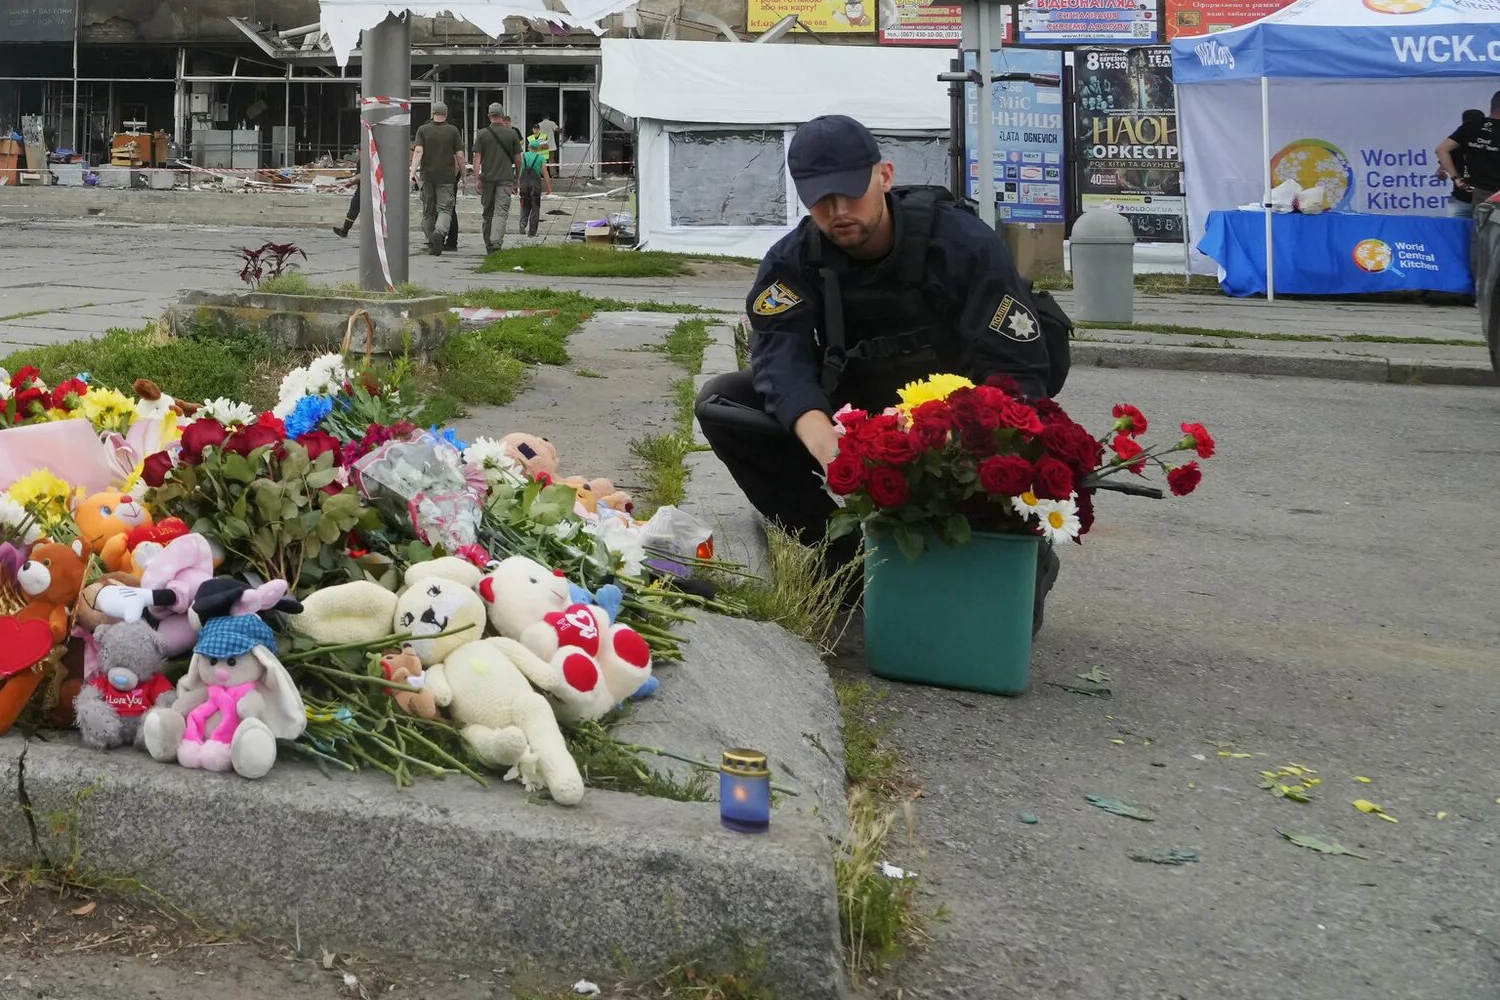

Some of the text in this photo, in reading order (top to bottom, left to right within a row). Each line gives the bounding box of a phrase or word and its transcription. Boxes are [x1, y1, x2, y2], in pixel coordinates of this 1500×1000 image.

[1086, 52, 1100, 71] 8
[1100, 61, 1127, 69] 19:30
[1023, 132, 1058, 144] OGNEVICH
[1360, 149, 1428, 167] World
[1394, 241, 1426, 252] World
[1398, 250, 1436, 262] Central
[1399, 260, 1439, 272] Kitchen
[126, 694, 143, 708] You
